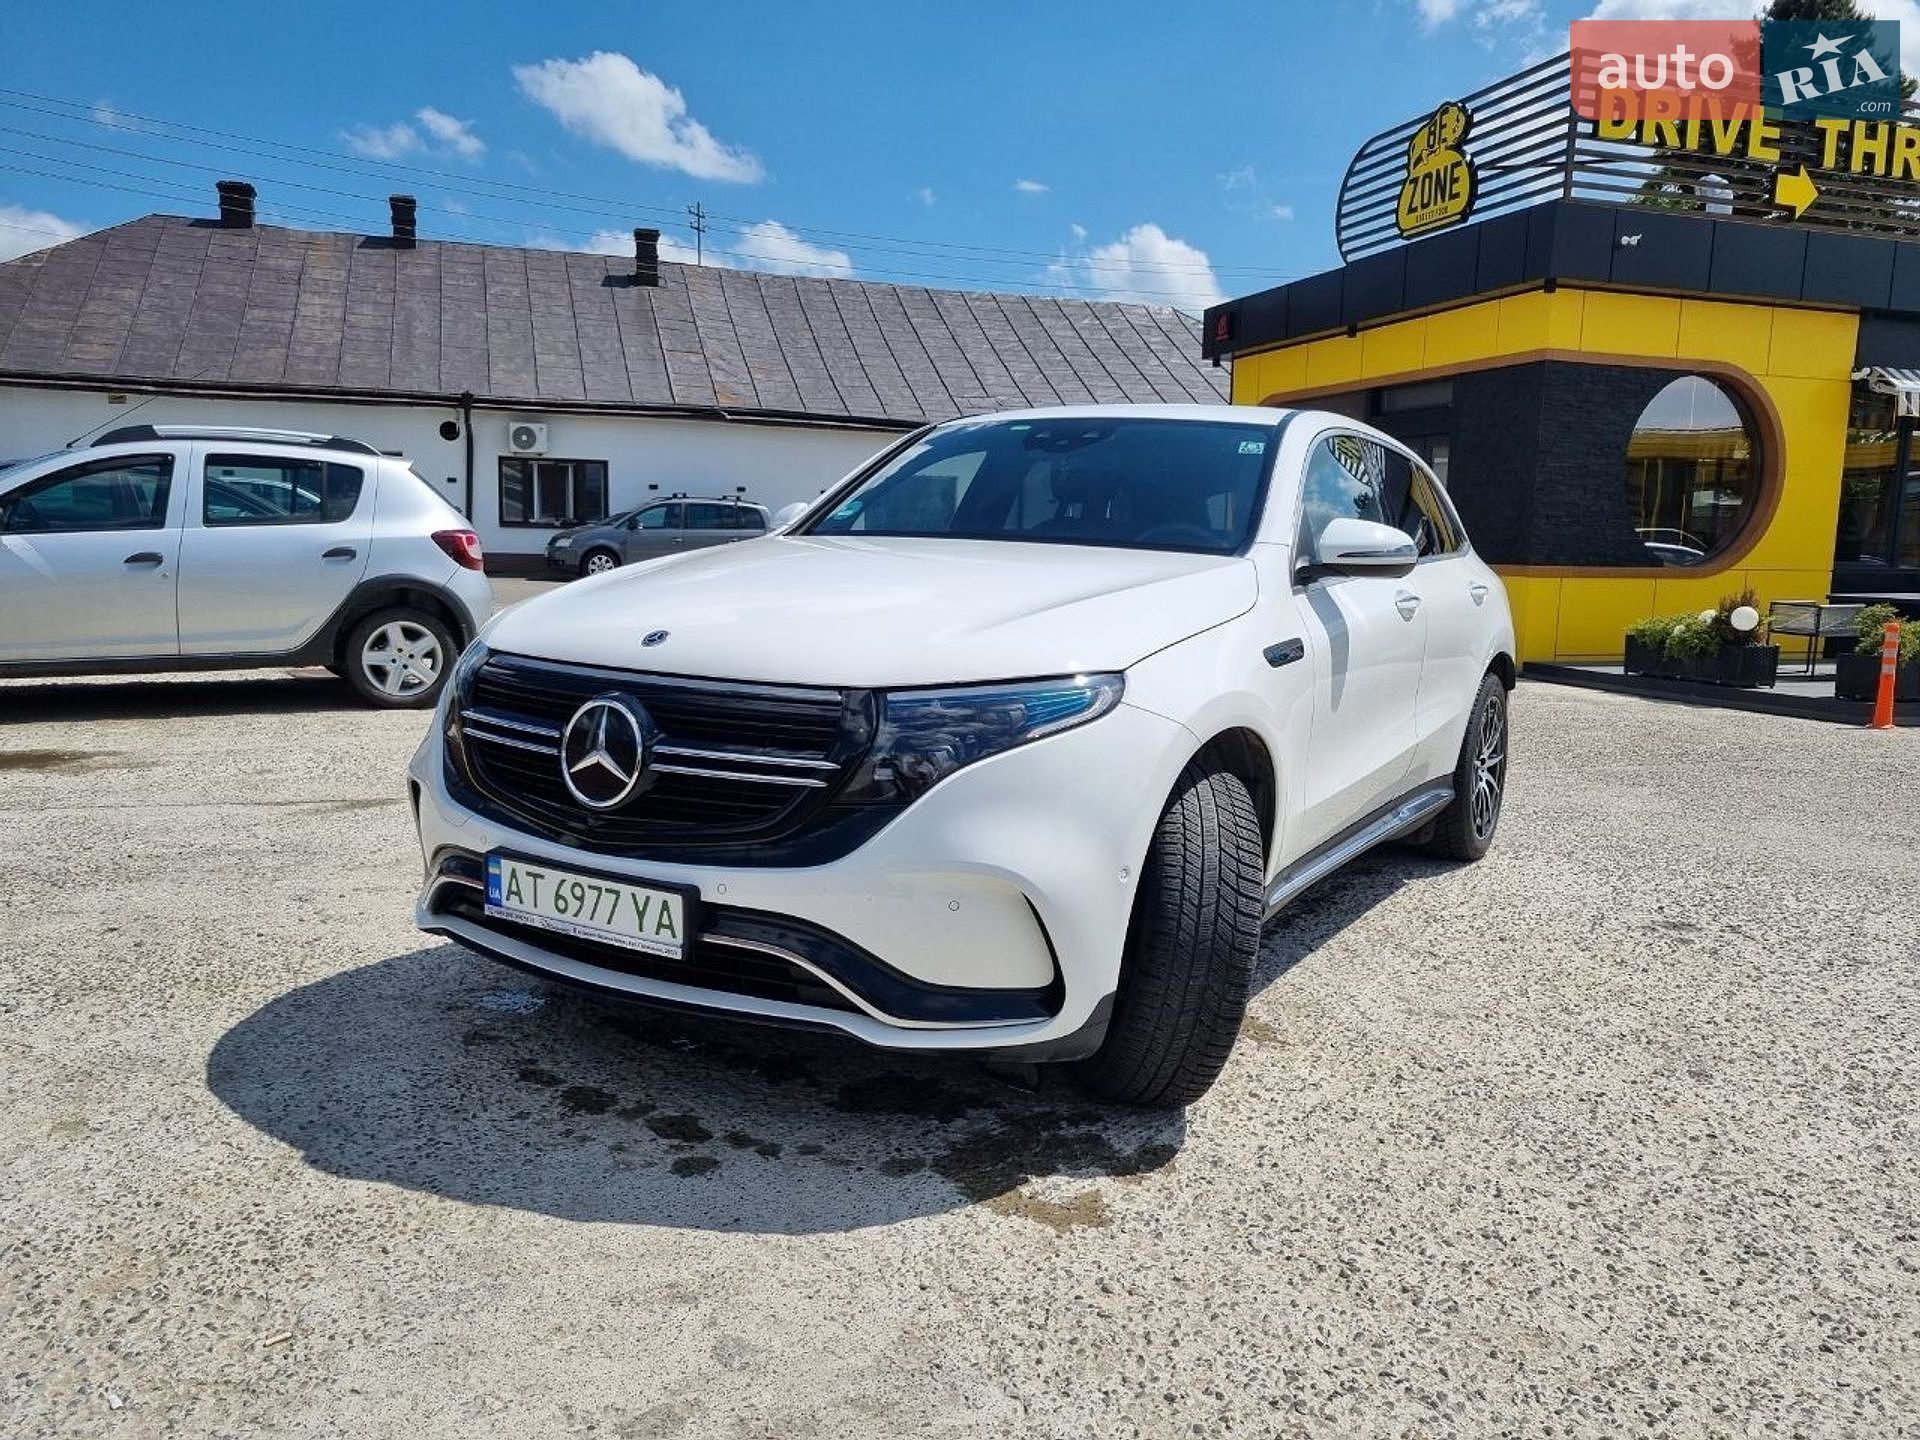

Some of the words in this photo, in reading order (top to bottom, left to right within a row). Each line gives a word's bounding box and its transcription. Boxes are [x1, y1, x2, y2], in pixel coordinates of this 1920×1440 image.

[1597, 88, 1784, 163] DRIVE
[1407, 160, 1463, 215] ZONE
[488, 886, 501, 899] UA
[505, 866, 546, 909] AT
[553, 878, 622, 926] 6977
[631, 892, 678, 939] YA
